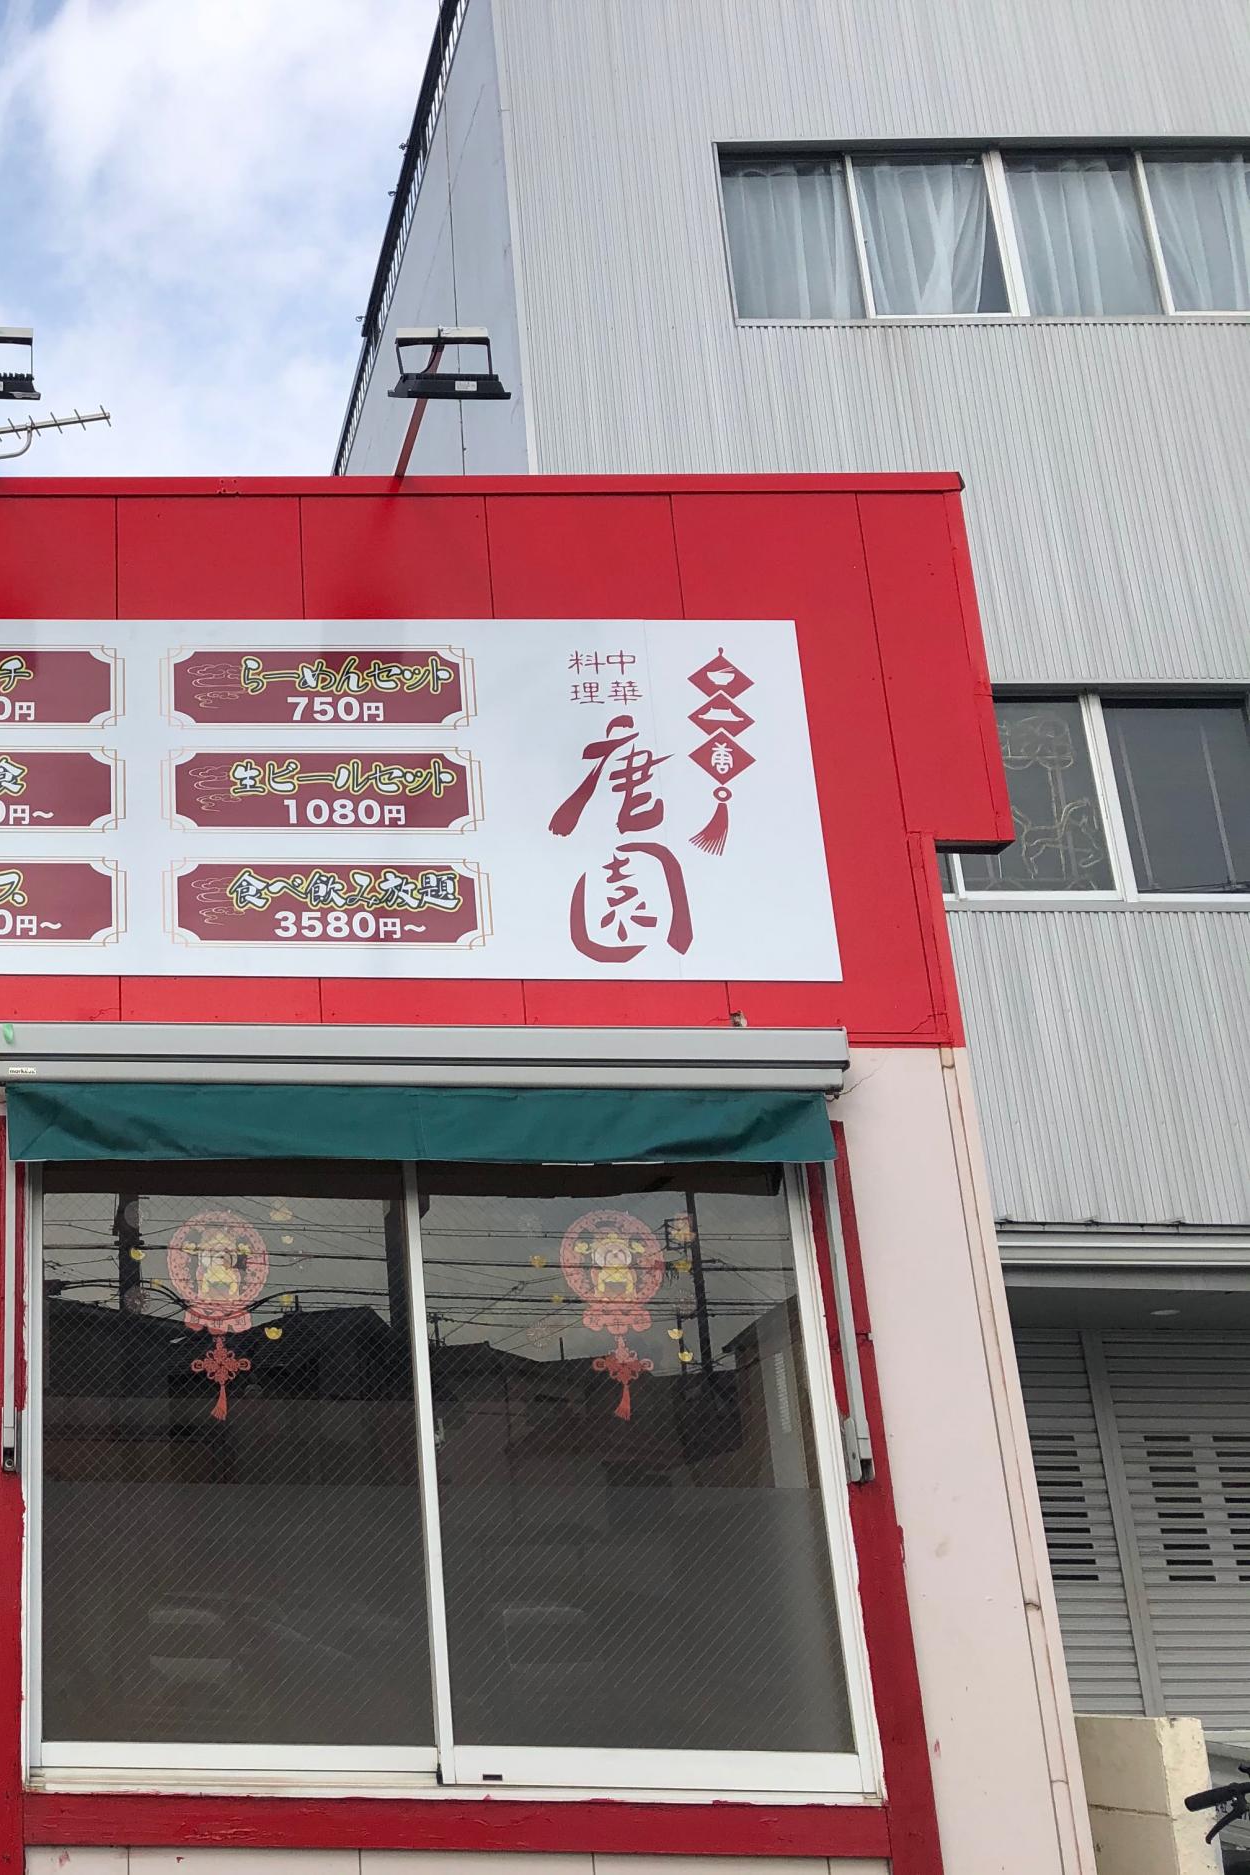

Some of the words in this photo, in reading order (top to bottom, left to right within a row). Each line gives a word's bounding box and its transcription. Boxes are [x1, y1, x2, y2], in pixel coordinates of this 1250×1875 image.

[240, 657, 454, 694] らーめんセット
[286, 696, 385, 723] 750円
[230, 759, 458, 797] 生ビールセット
[283, 799, 407, 826] 1080円
[227, 868, 463, 912] 食べ飲み放題
